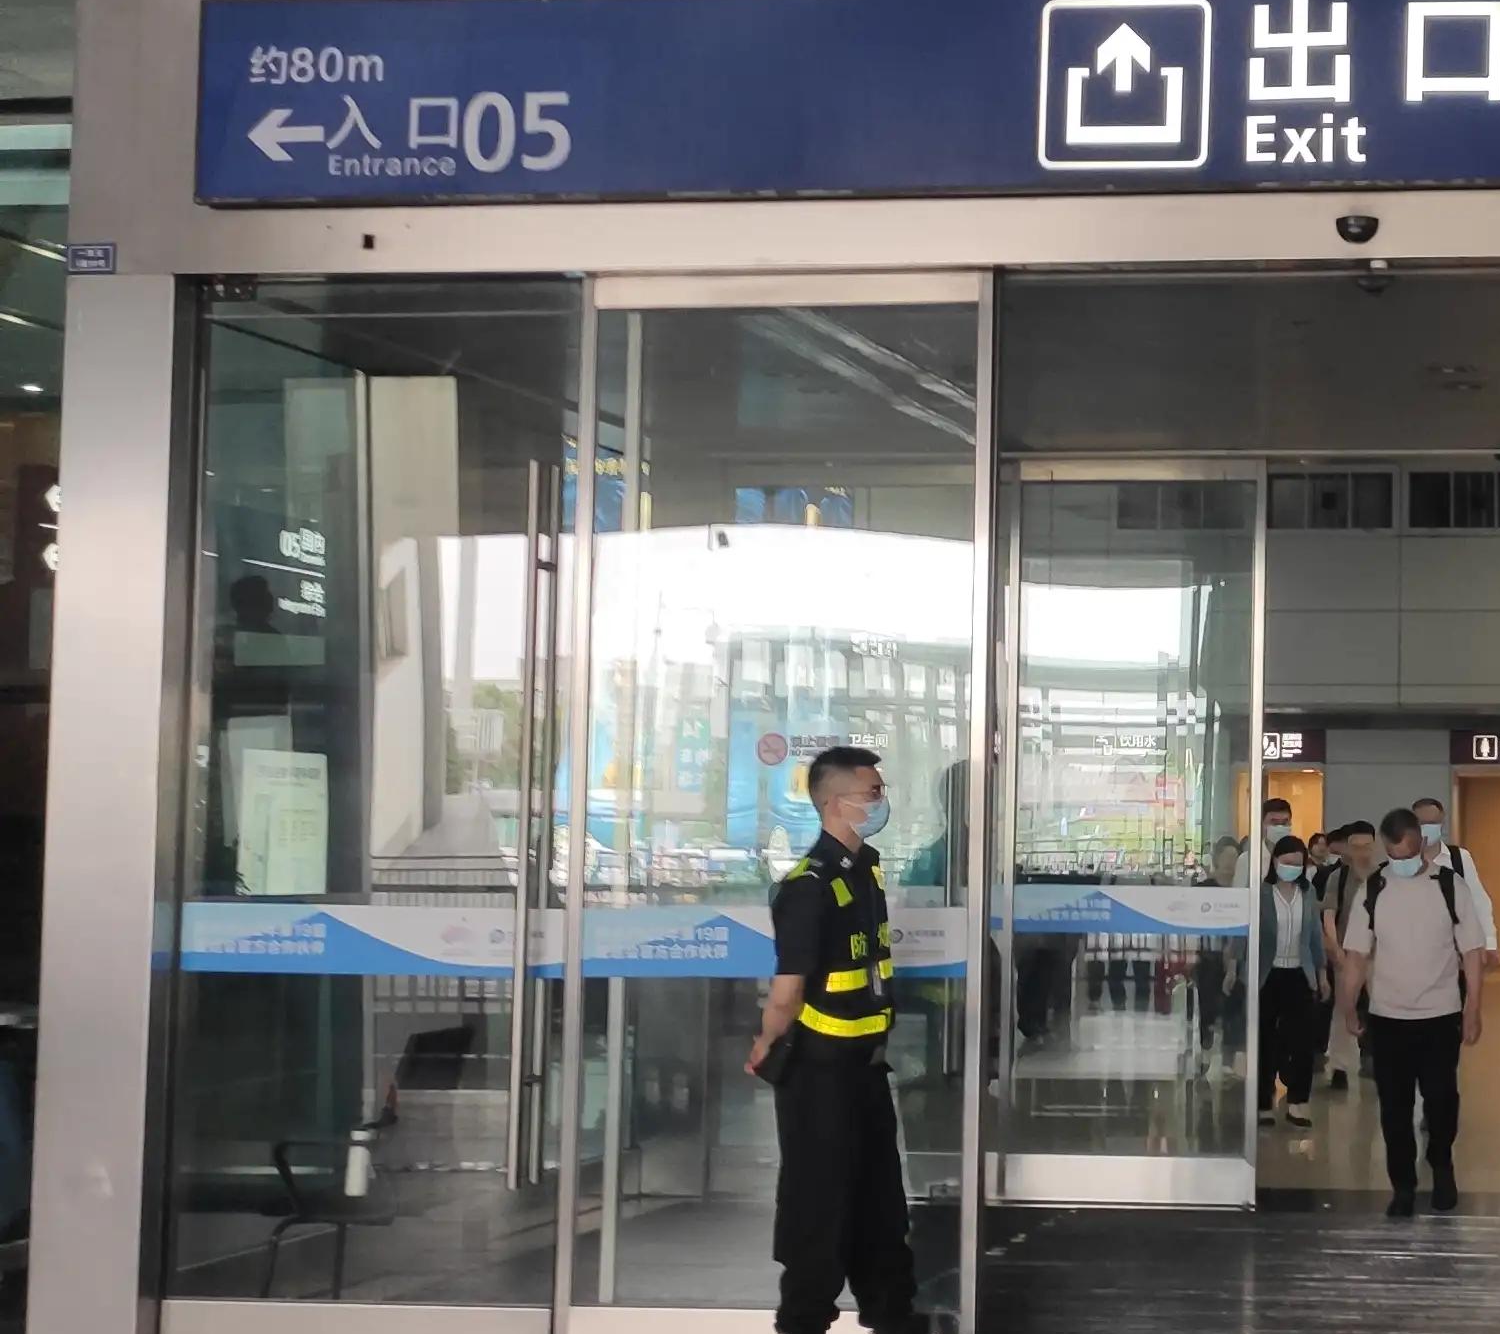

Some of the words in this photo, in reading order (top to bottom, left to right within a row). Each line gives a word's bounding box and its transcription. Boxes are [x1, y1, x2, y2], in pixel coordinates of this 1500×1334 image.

[249, 45, 385, 85] 约80m
[326, 94, 459, 150] 入口
[462, 90, 573, 173] 05
[1245, 113, 1367, 163] Exit
[328, 153, 457, 177] Entrance
